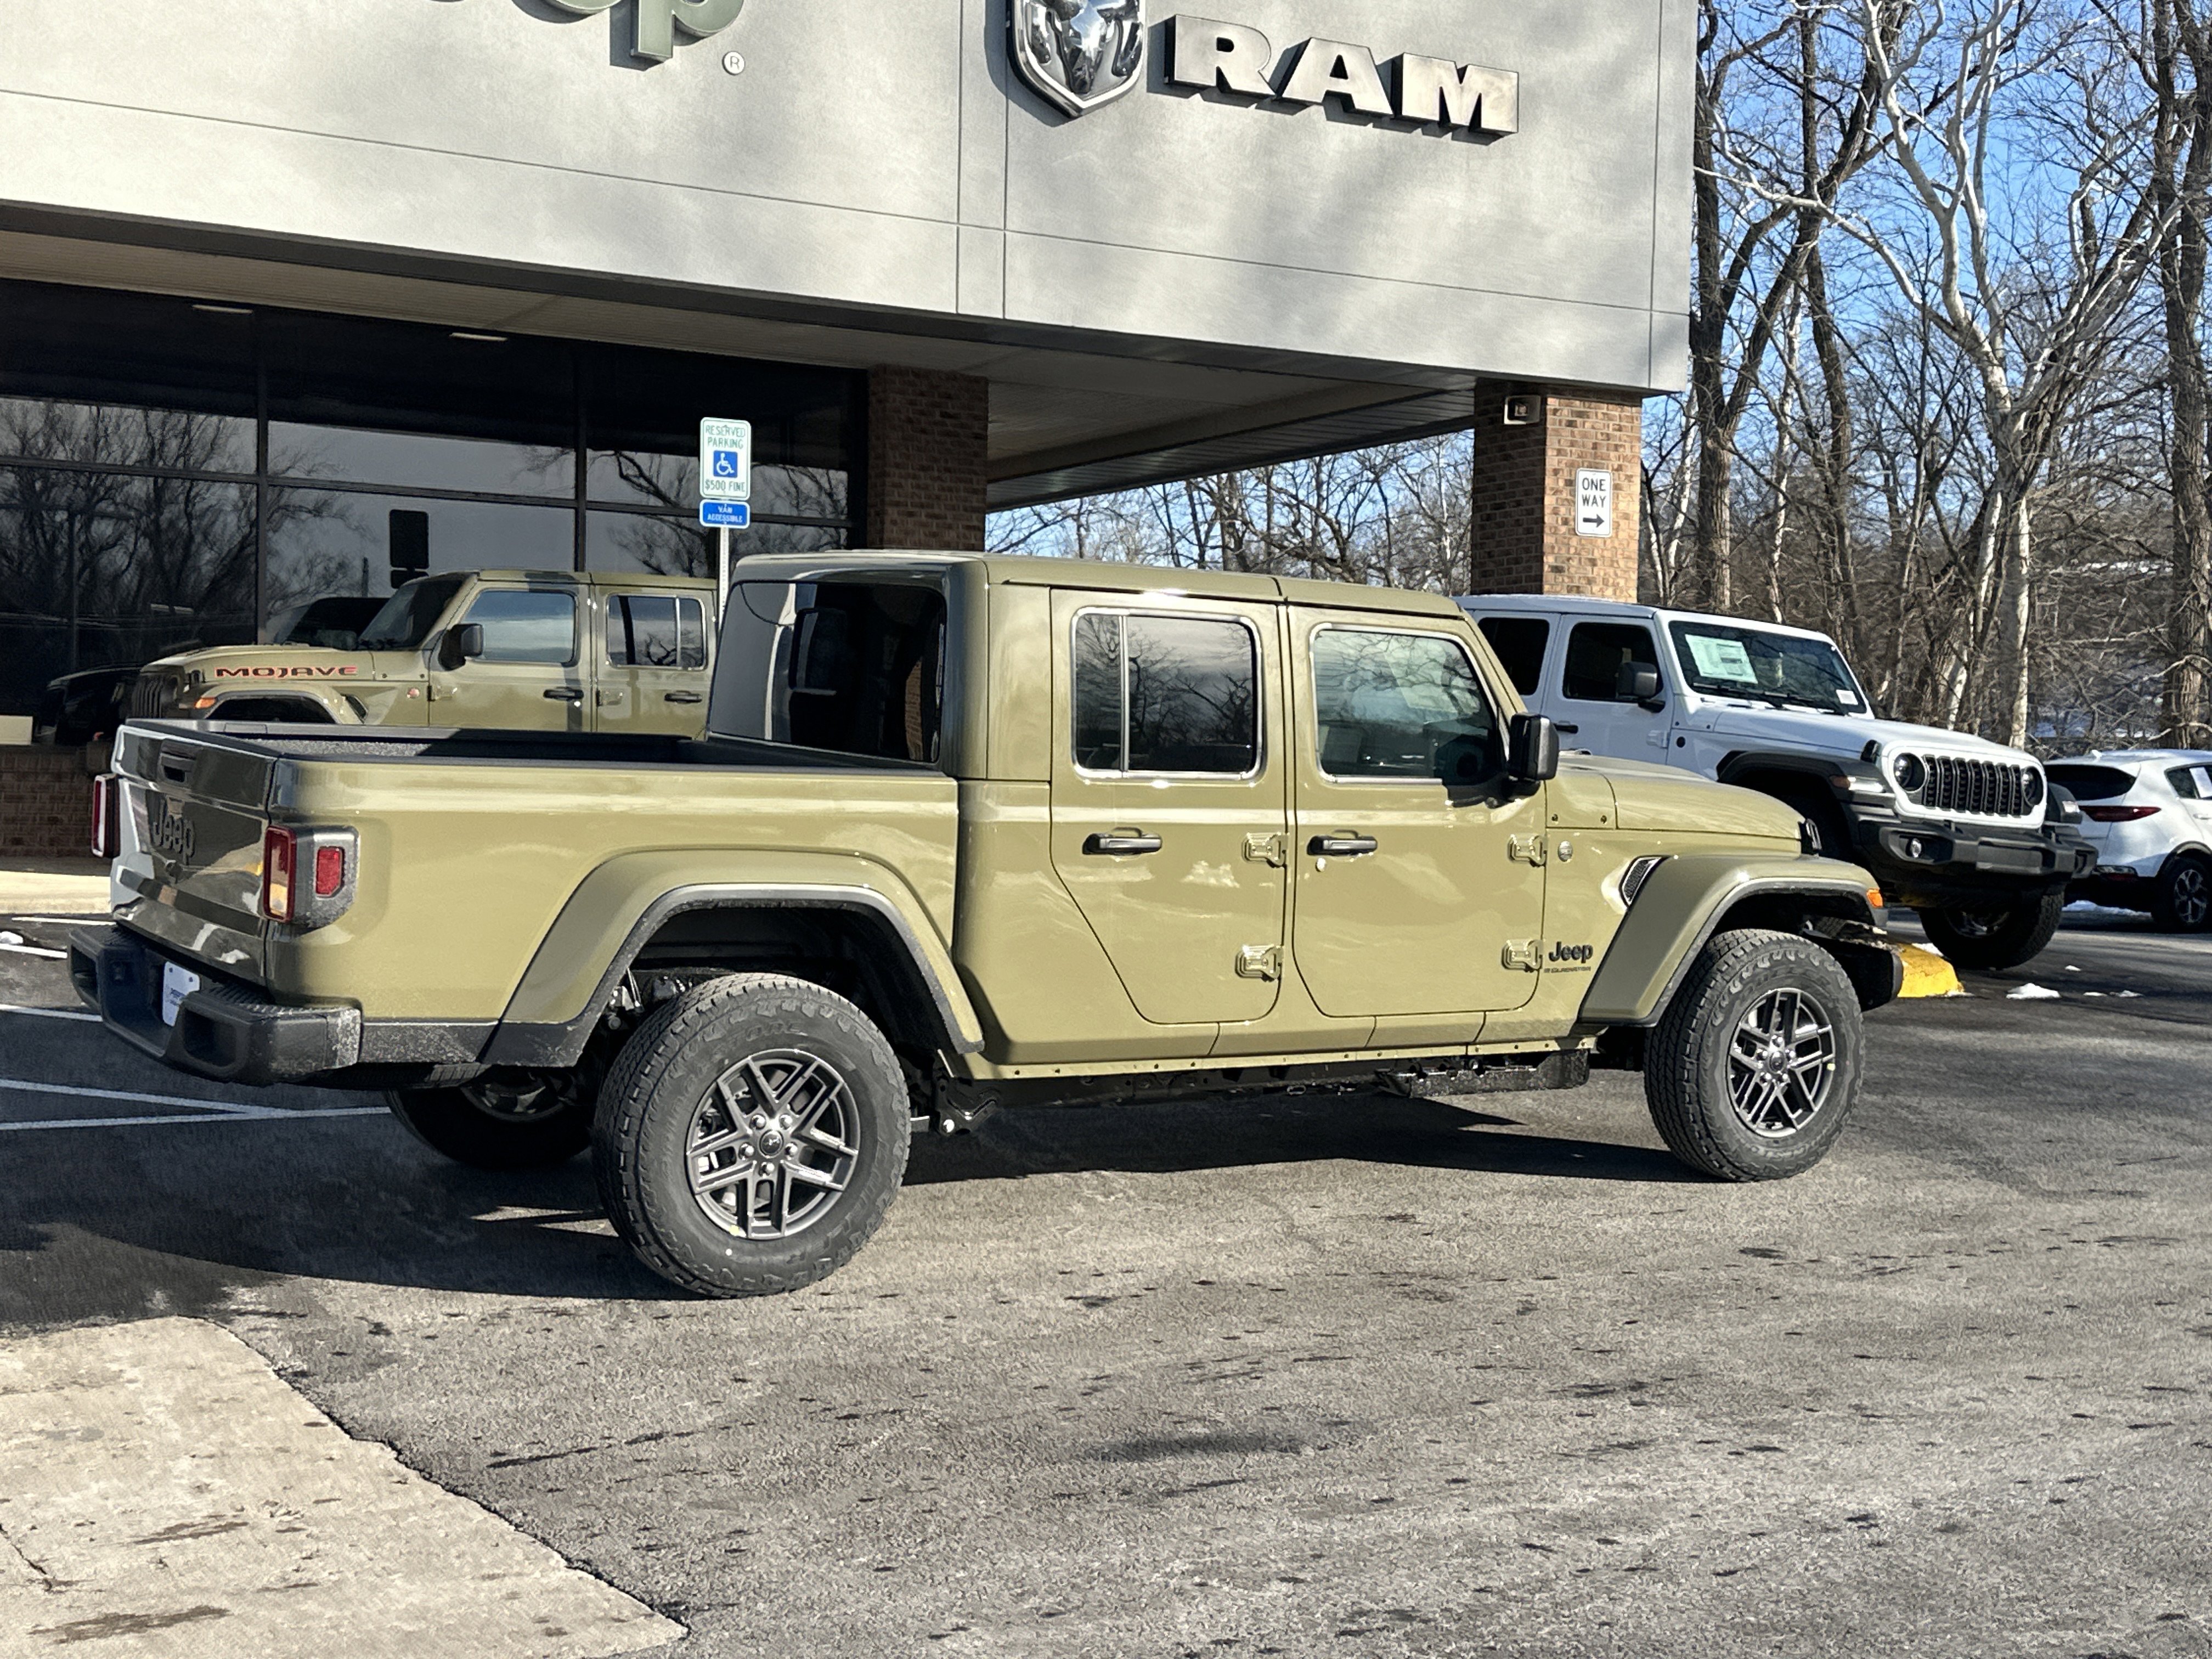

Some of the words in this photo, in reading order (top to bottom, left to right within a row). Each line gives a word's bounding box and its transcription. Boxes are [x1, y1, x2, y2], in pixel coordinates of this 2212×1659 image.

[1166, 14, 1519, 134] RAM
[706, 425, 746, 438] RESERVED
[707, 437, 744, 449] PARKING
[705, 479, 726, 492] $500
[729, 481, 746, 493] FINE
[1582, 477, 1606, 492] ONE
[1582, 494, 1606, 508] WAY
[718, 505, 733, 514] VAN
[215, 666, 358, 679] MOJAVE
[1548, 941, 1593, 964] Jeep
